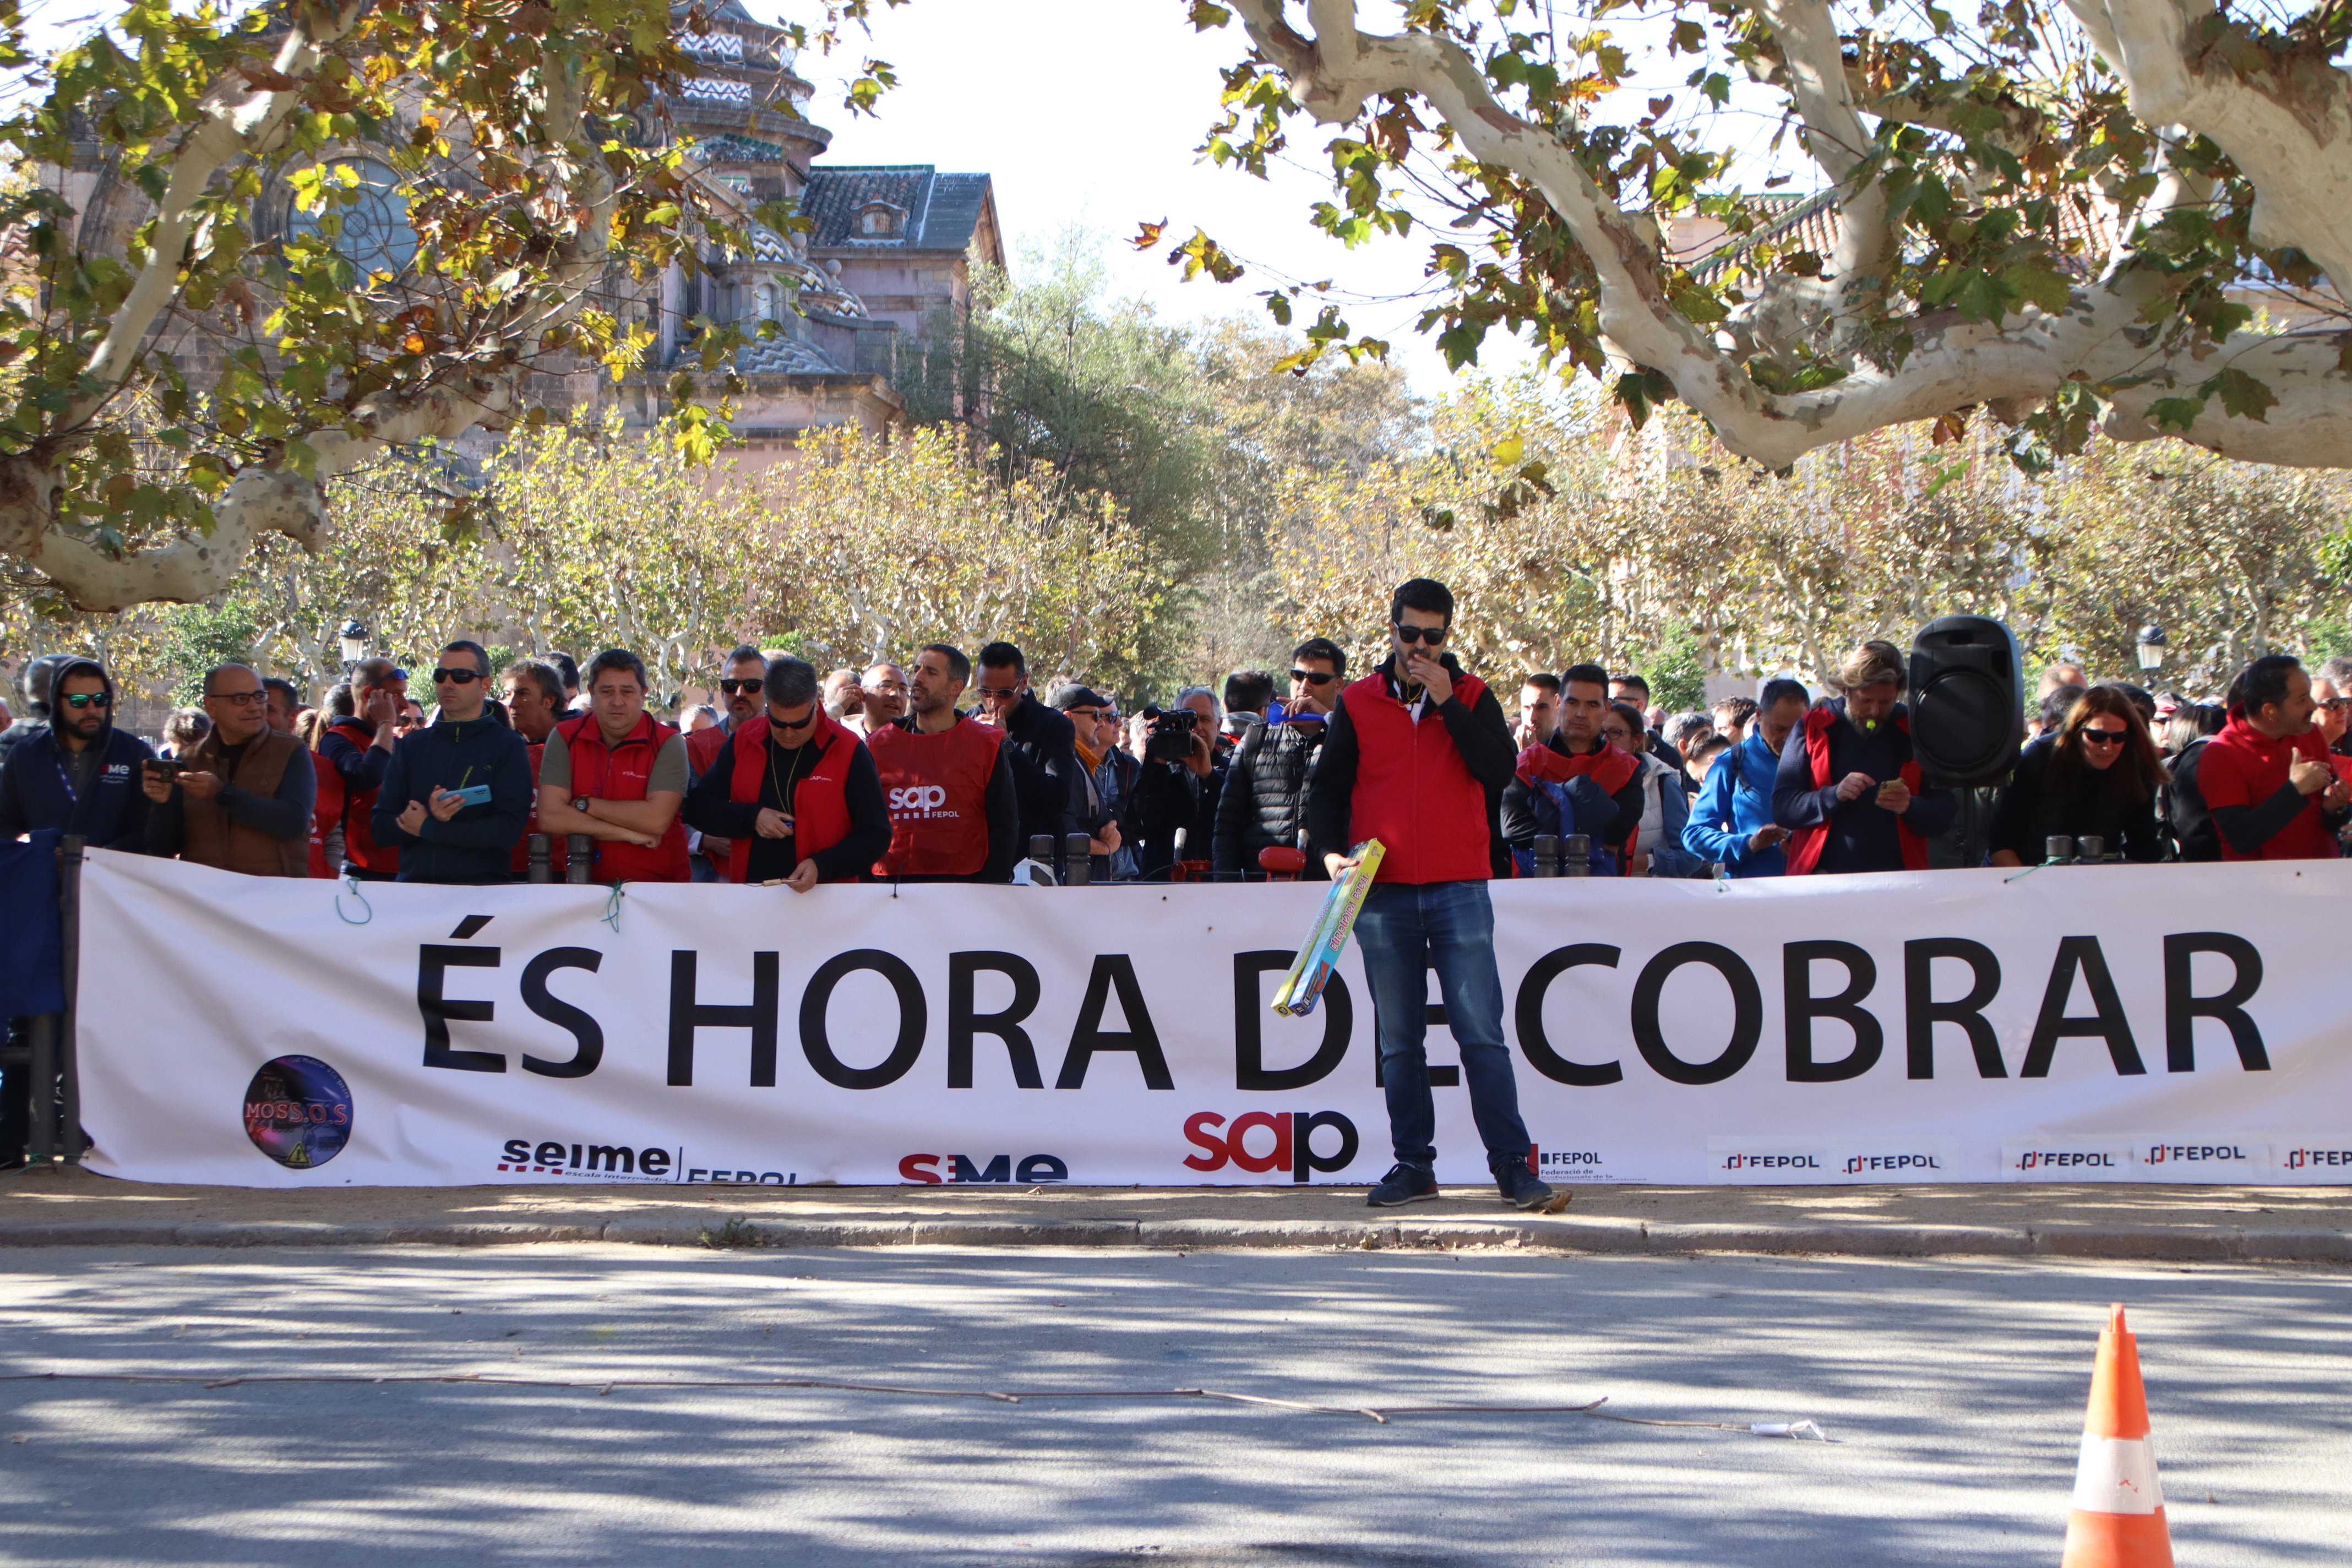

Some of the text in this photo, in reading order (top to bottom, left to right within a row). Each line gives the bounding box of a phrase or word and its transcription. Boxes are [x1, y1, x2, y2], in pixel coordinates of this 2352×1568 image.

[889, 785, 946, 812] sap
[418, 915, 604, 1079] ÉS
[667, 949, 1174, 1090] HORA
[1515, 932, 2271, 1086] COBRAR
[1182, 1110, 1359, 1183] sap
[2174, 1146, 2246, 1161] FEPOL
[1552, 1152, 1603, 1164] FEPOL
[1750, 1156, 1820, 1168] FEPOL
[1871, 1155, 1941, 1170] FEPOL
[2044, 1153, 2115, 1167] FEPOL
